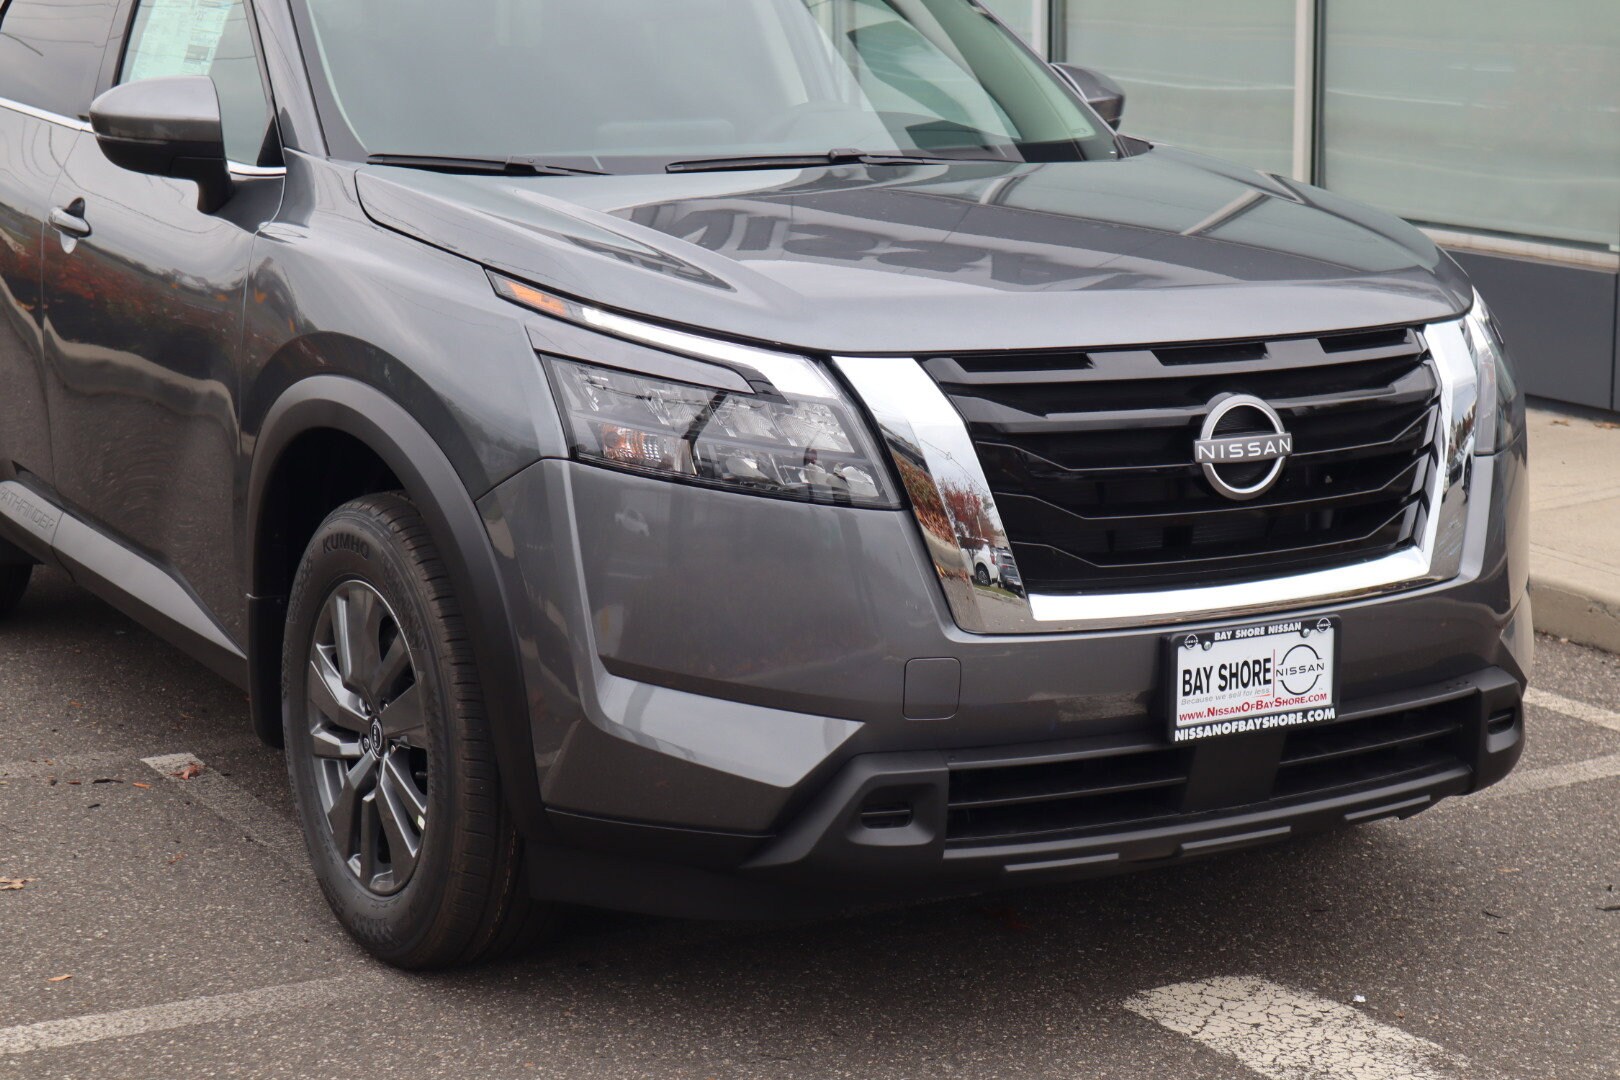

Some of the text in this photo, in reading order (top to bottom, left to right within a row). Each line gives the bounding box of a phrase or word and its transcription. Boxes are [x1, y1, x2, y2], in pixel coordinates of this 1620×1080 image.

[1198, 438, 1291, 460] NISSAN
[322, 532, 370, 560] KUMHO
[1214, 621, 1302, 641] BAY SHORE NISSAN
[1182, 657, 1272, 697] BAY SHORE
[1276, 662, 1325, 677] NISSAN
[1181, 687, 1270, 706] Because we sell for less
[1174, 707, 1336, 742] NISSANOFBAYSHORE.COM
